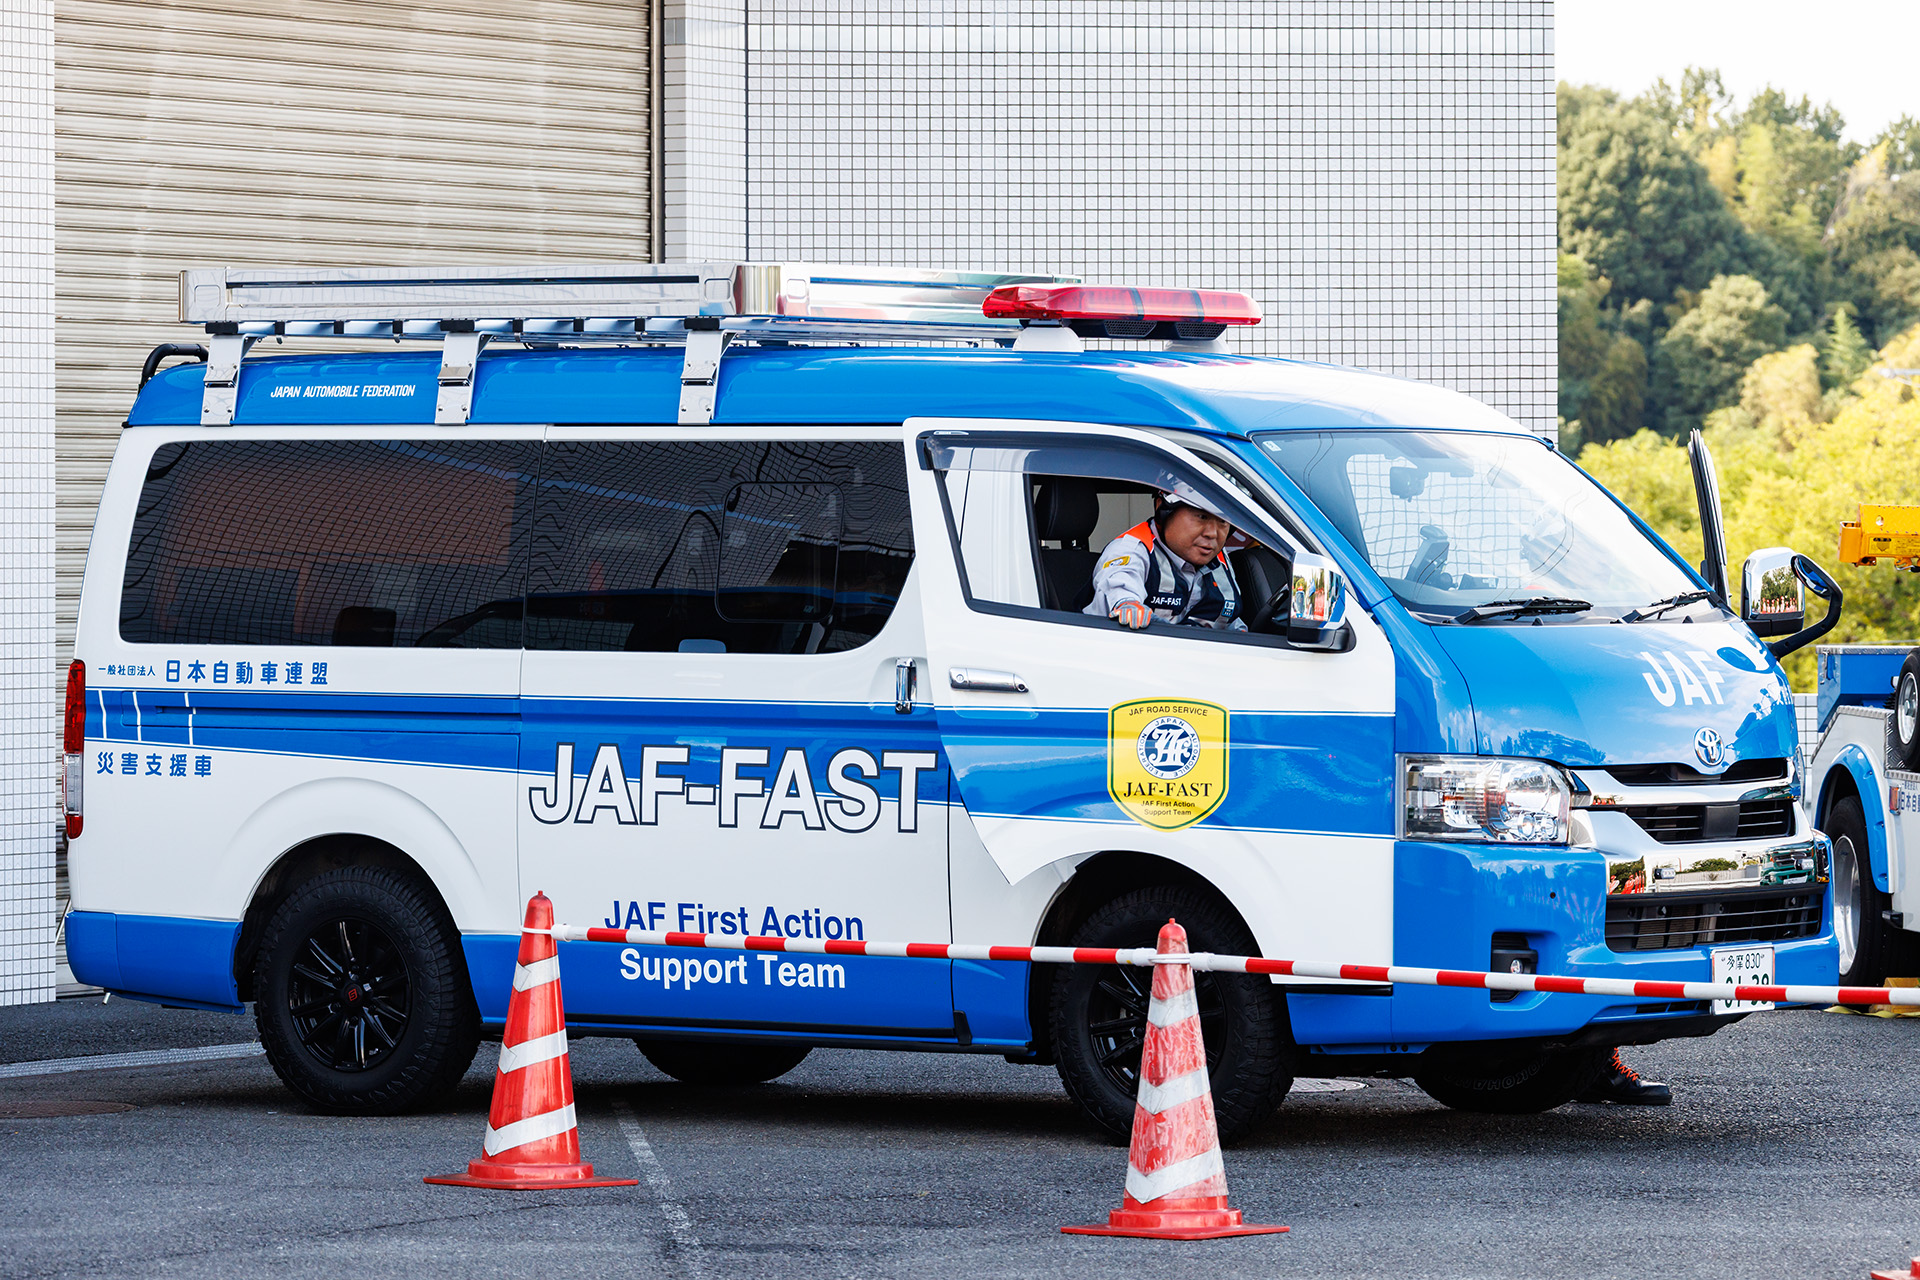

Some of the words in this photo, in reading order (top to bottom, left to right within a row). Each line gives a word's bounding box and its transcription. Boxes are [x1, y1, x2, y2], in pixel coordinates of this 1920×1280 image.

[270, 385, 301, 398] JAPAN
[303, 385, 360, 397] AUTOMOBILE
[361, 384, 416, 397] FEDERATION
[1150, 596, 1182, 606] JAF-FAST
[98, 664, 156, 677] 一般社団法人
[165, 659, 329, 685] 日本自動車連盟
[1640, 651, 1725, 707] JAF
[1128, 707, 1144, 716] JAF
[1146, 706, 1171, 714] ROAD
[1172, 706, 1208, 717] SERVICE
[1155, 718, 1184, 726] JAPAN
[97, 751, 213, 778] 災害支援車
[528, 742, 939, 834] JAF-FAST
[1123, 782, 1213, 798] JAF-FAST
[604, 900, 666, 931] JAF
[677, 902, 750, 936] First
[760, 906, 864, 940] Action
[620, 947, 748, 990] Support
[757, 953, 846, 988] Team
